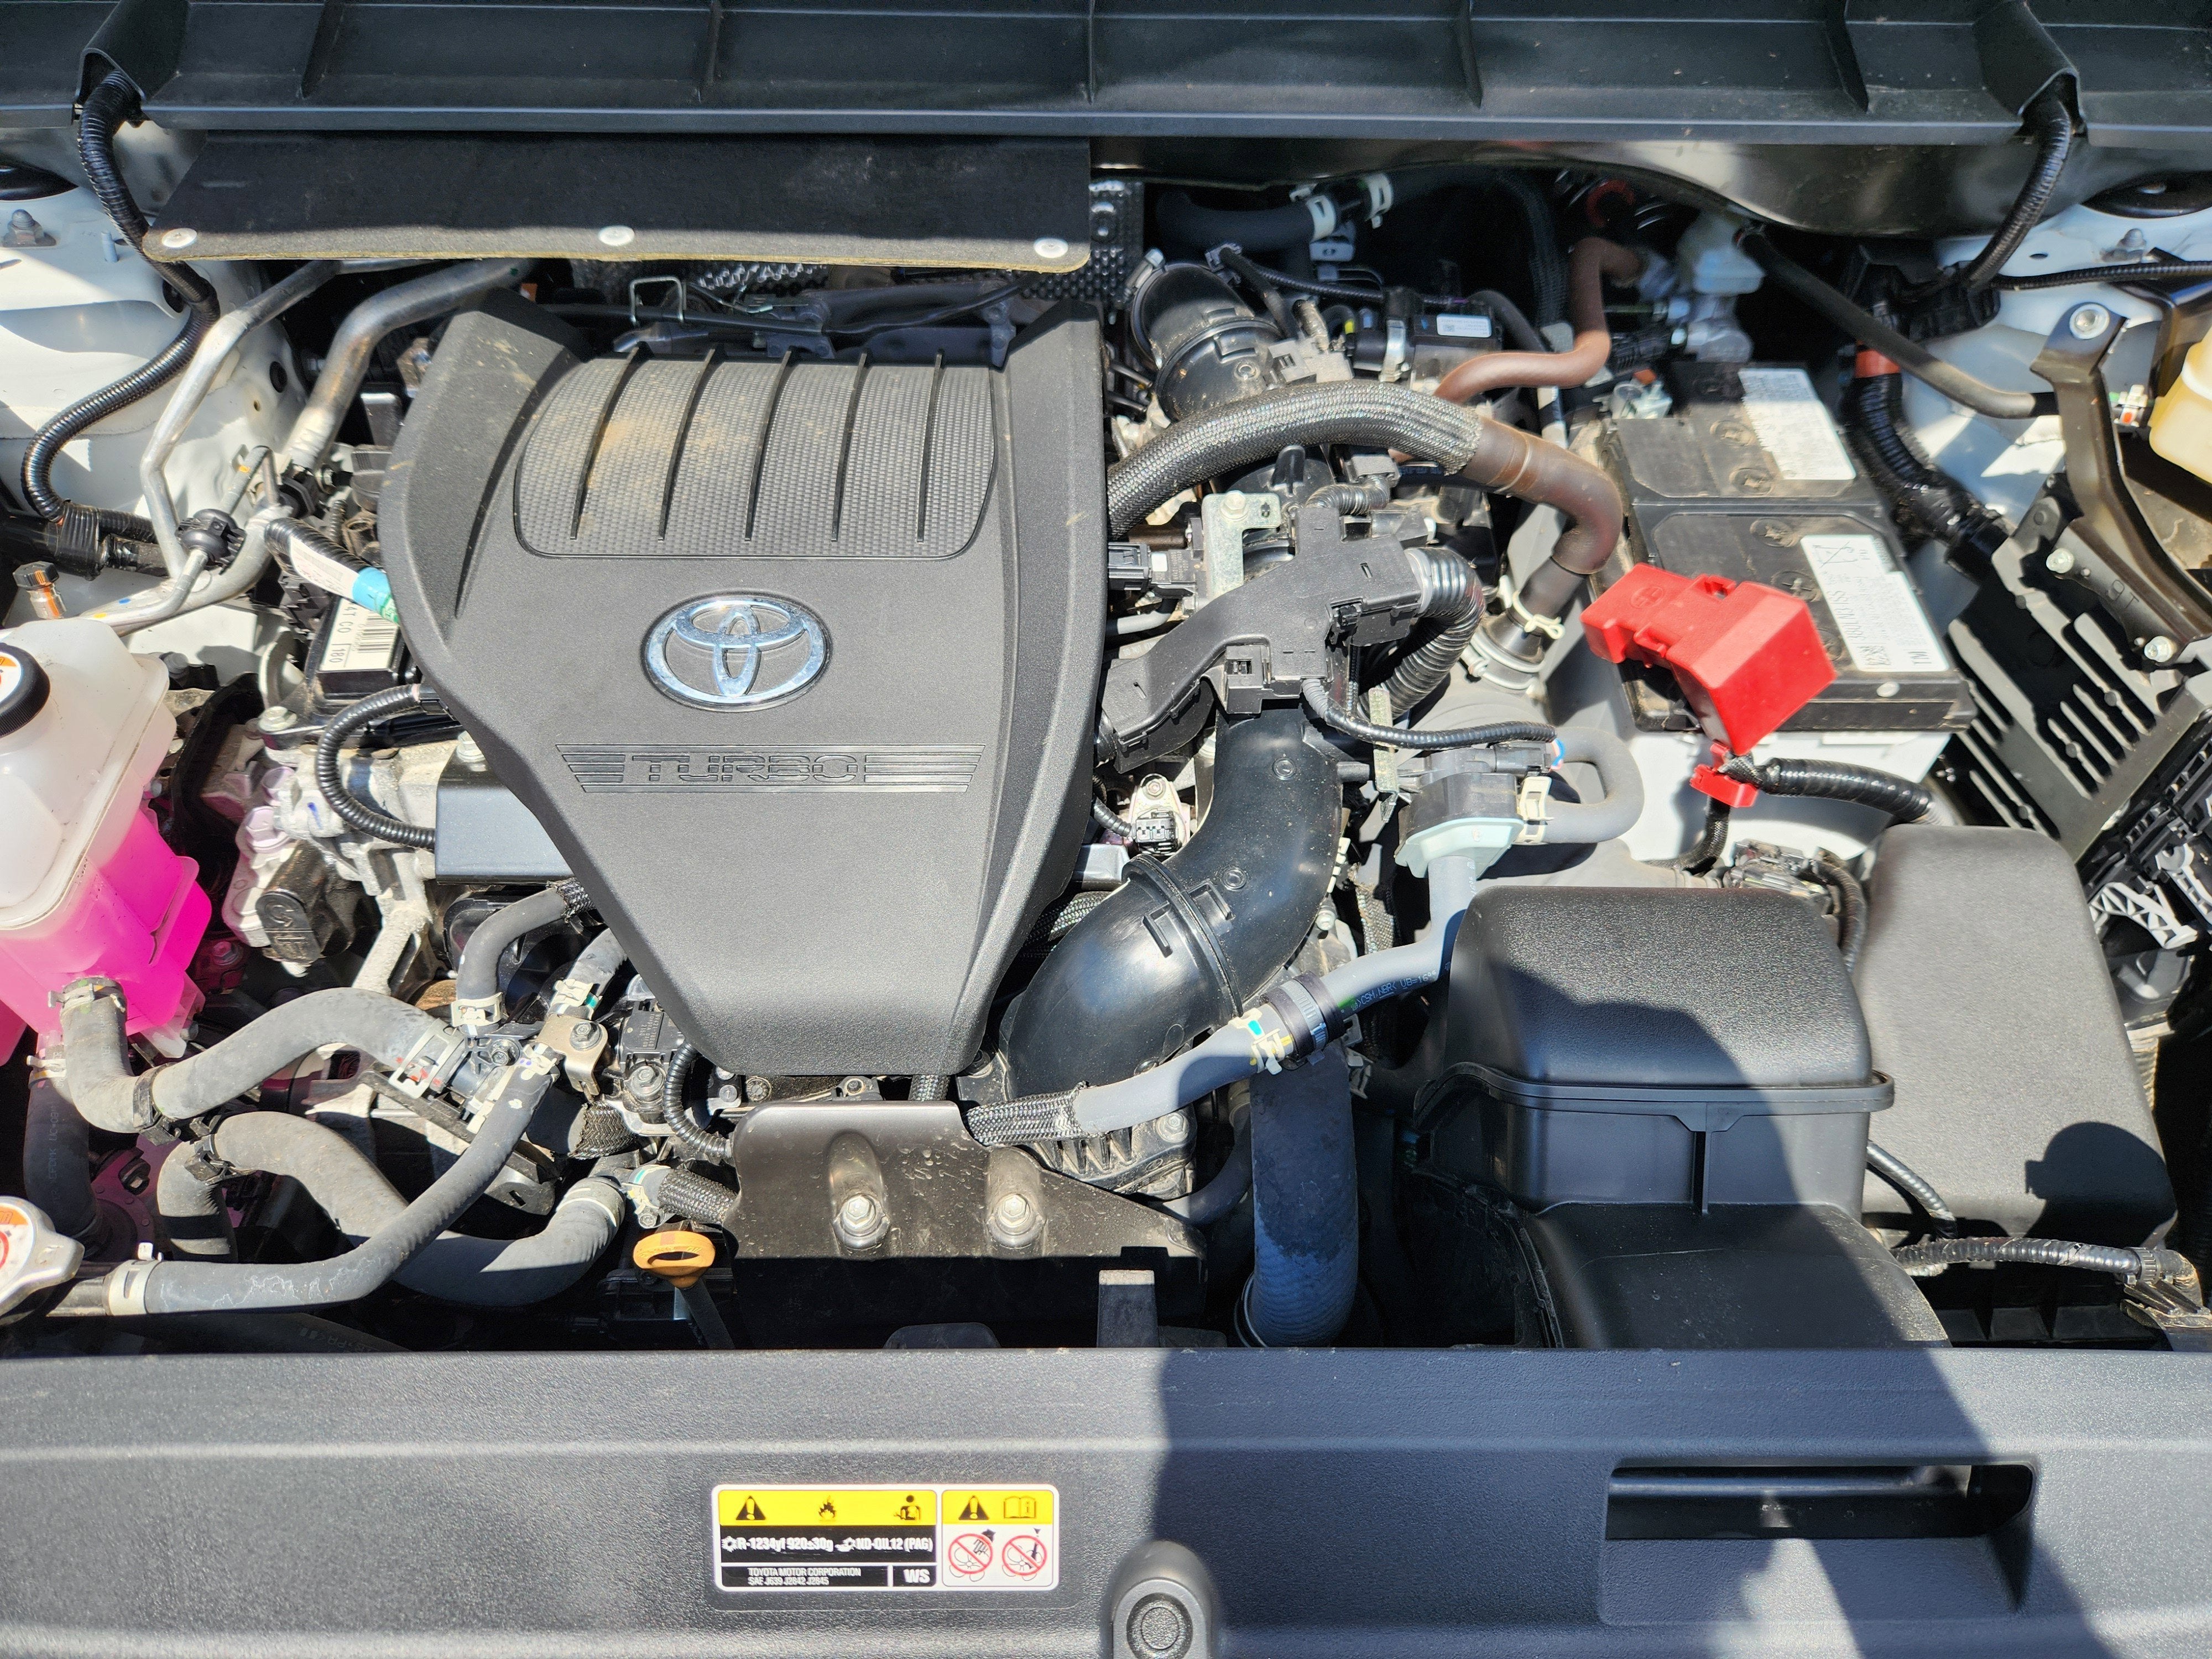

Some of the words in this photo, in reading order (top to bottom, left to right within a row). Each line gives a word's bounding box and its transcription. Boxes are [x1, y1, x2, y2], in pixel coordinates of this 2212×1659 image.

[329, 649, 346, 662] 180
[632, 755, 858, 782] TURBO
[737, 1537, 786, 1552] R-1234yf
[904, 1537, 933, 1553] (PAG)
[747, 1567, 779, 1577] TOYOTA
[778, 1567, 807, 1577] MOTOR
[807, 1567, 862, 1577] CORPORATION
[903, 1568, 931, 1583] WS
[764, 1577, 784, 1585] J639
